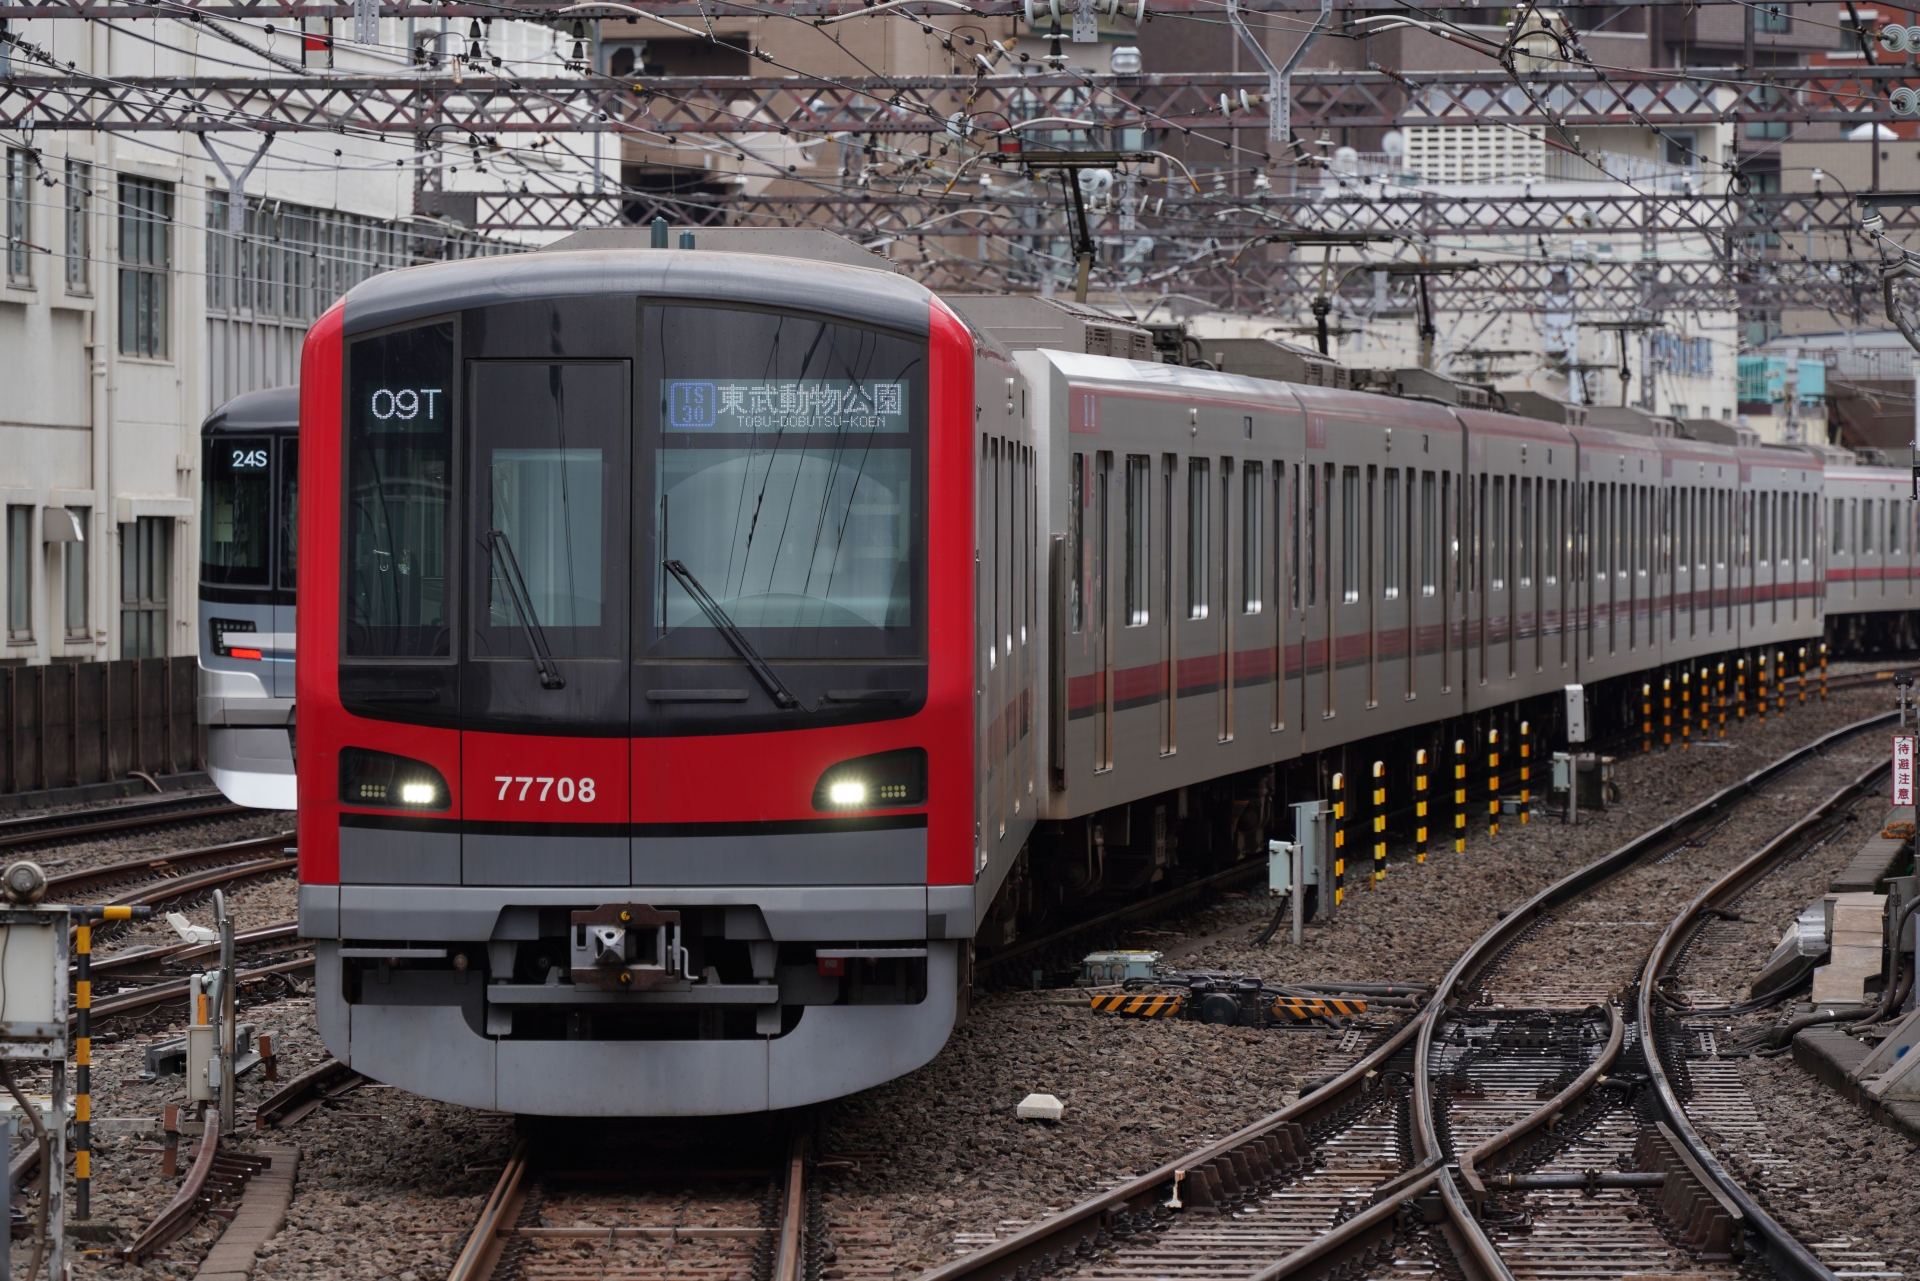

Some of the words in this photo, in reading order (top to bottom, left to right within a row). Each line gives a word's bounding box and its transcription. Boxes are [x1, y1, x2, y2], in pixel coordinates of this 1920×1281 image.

[371, 389, 443, 420] 09T
[682, 386, 704, 404] TS
[717, 383, 902, 416] 東武動物公園
[682, 405, 704, 423] 30
[736, 415, 886, 428] TOBU-DOBUTSU-KOEN
[231, 450, 268, 468] 24S
[1897, 743, 1910, 800] 待避注意
[494, 775, 597, 803] 77708
